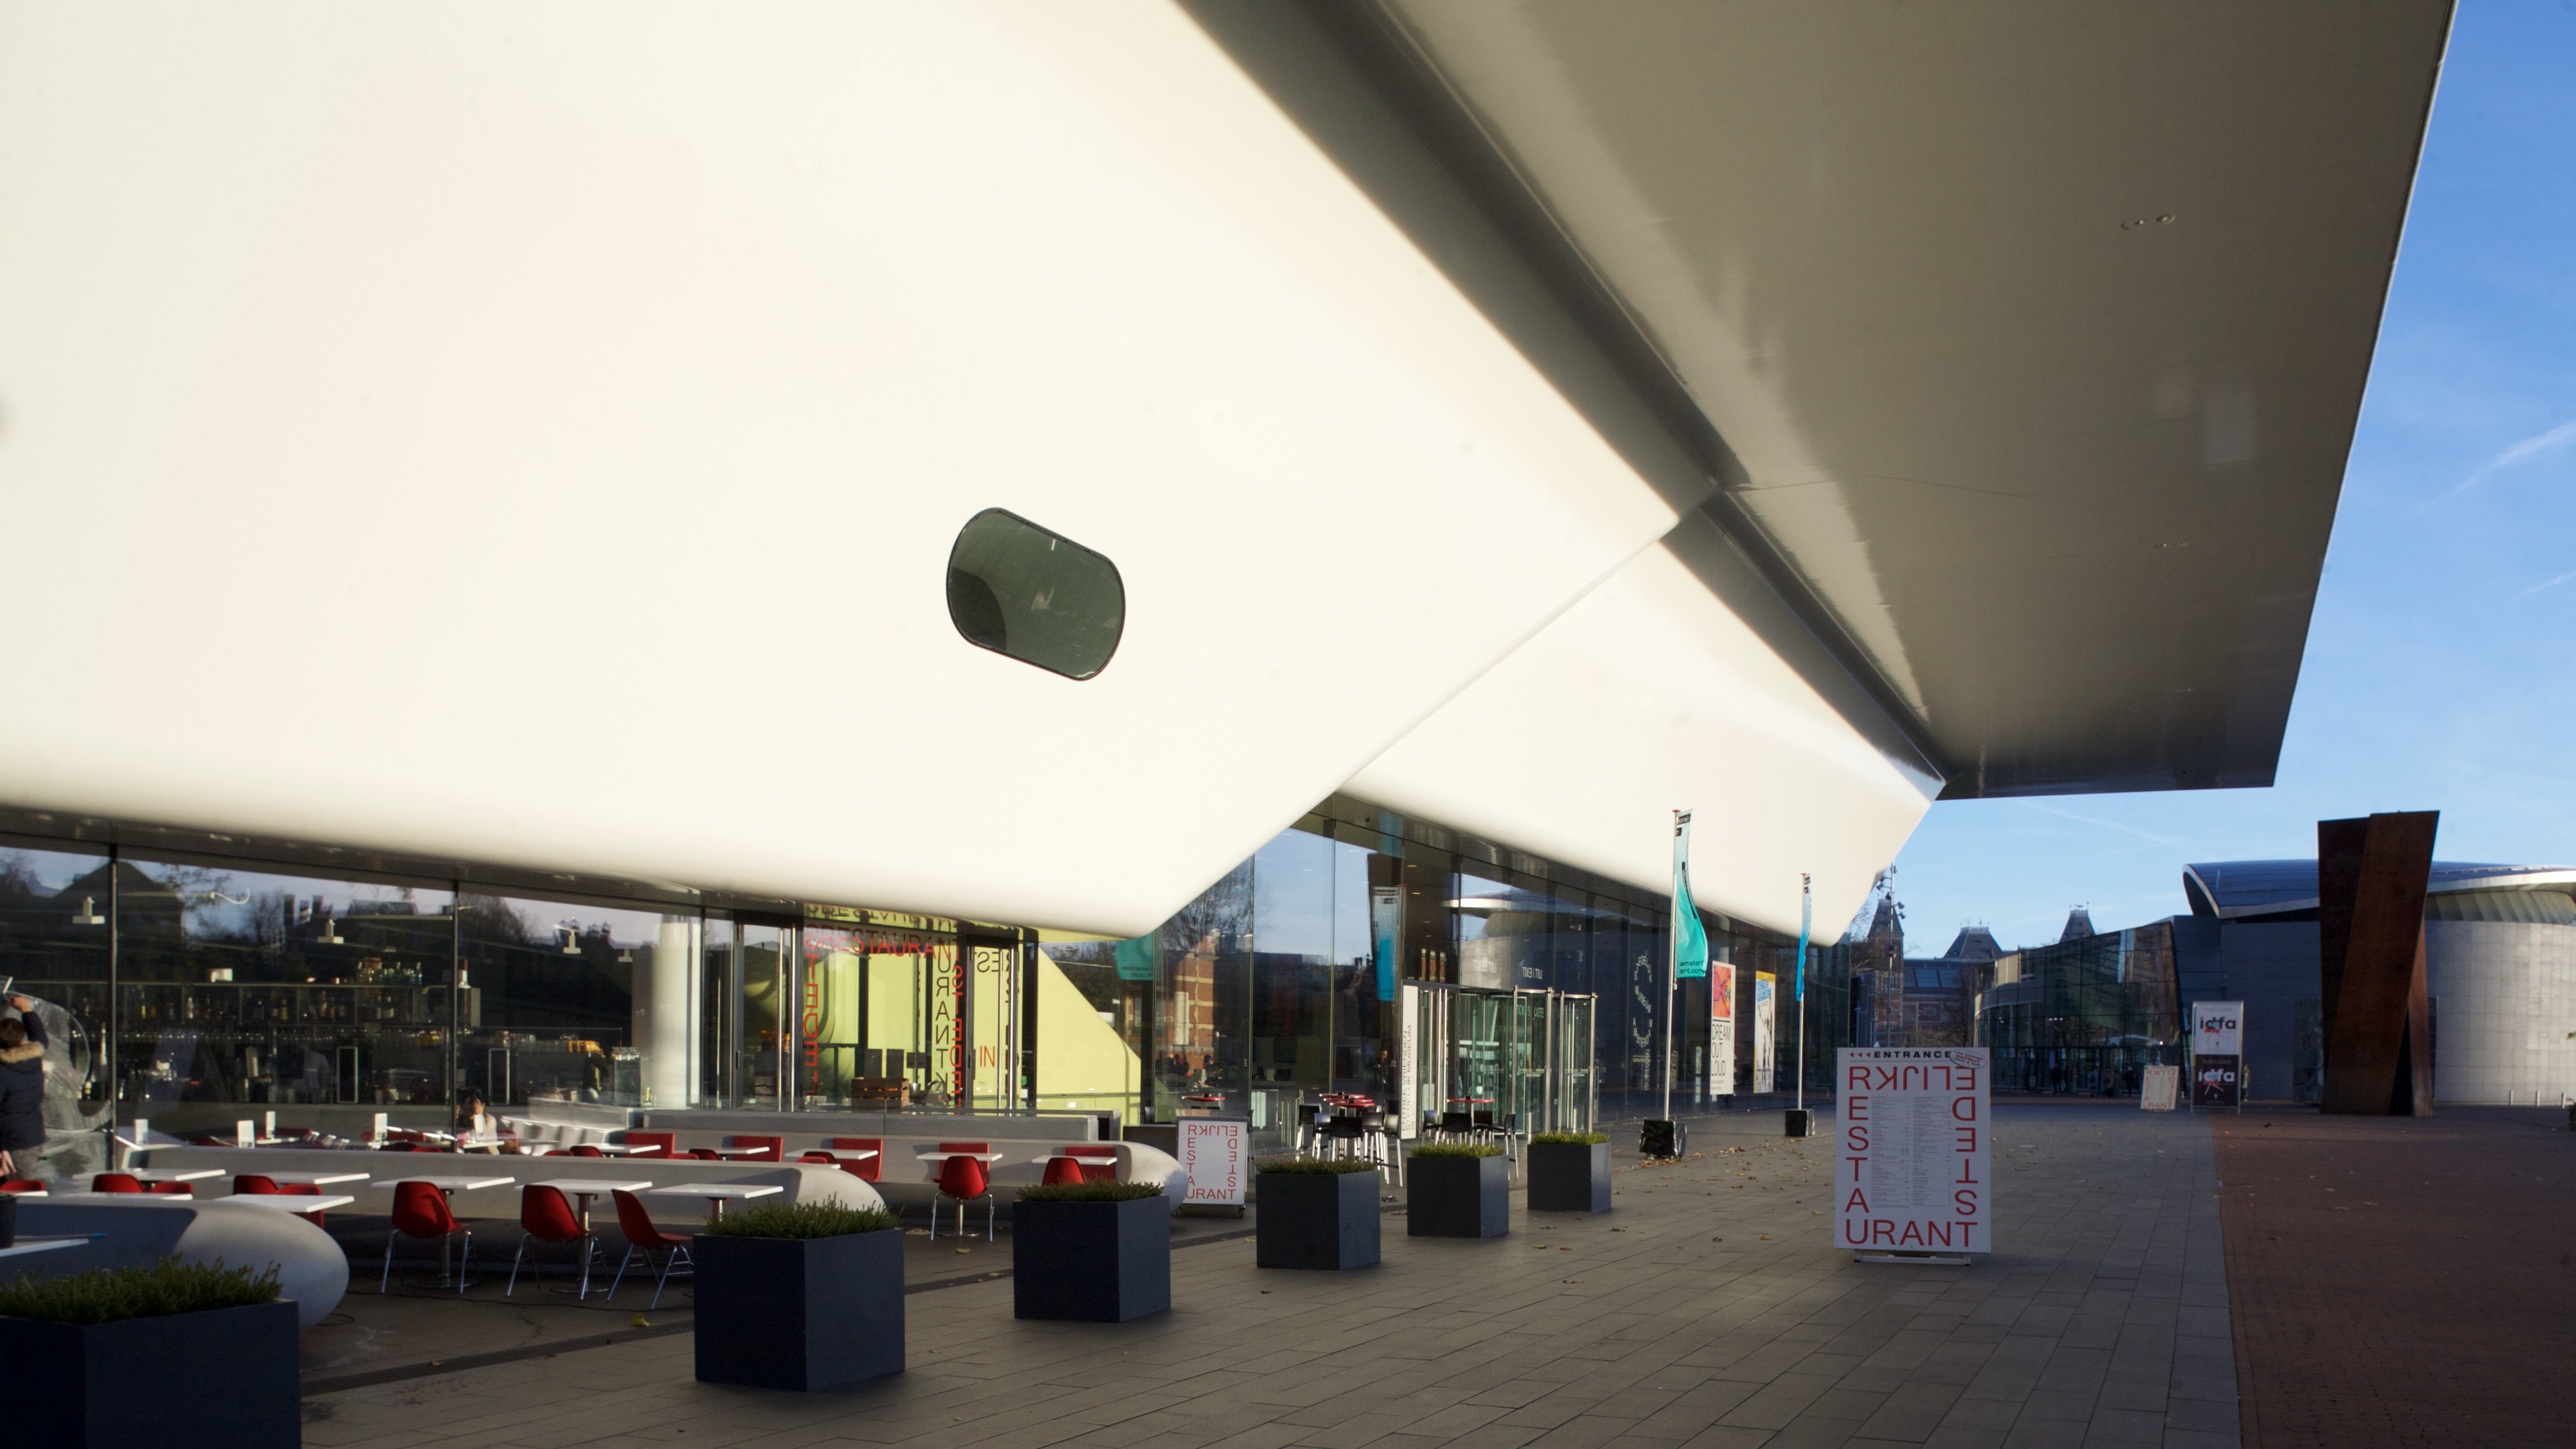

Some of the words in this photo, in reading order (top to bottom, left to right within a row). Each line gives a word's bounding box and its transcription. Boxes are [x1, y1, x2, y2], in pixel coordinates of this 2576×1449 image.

[1712, 1024, 1731, 1041] DREAM
[980, 1045, 995, 1067] IN
[1712, 1042, 1723, 1058] OUT
[1711, 1060, 1726, 1076] LOUD
